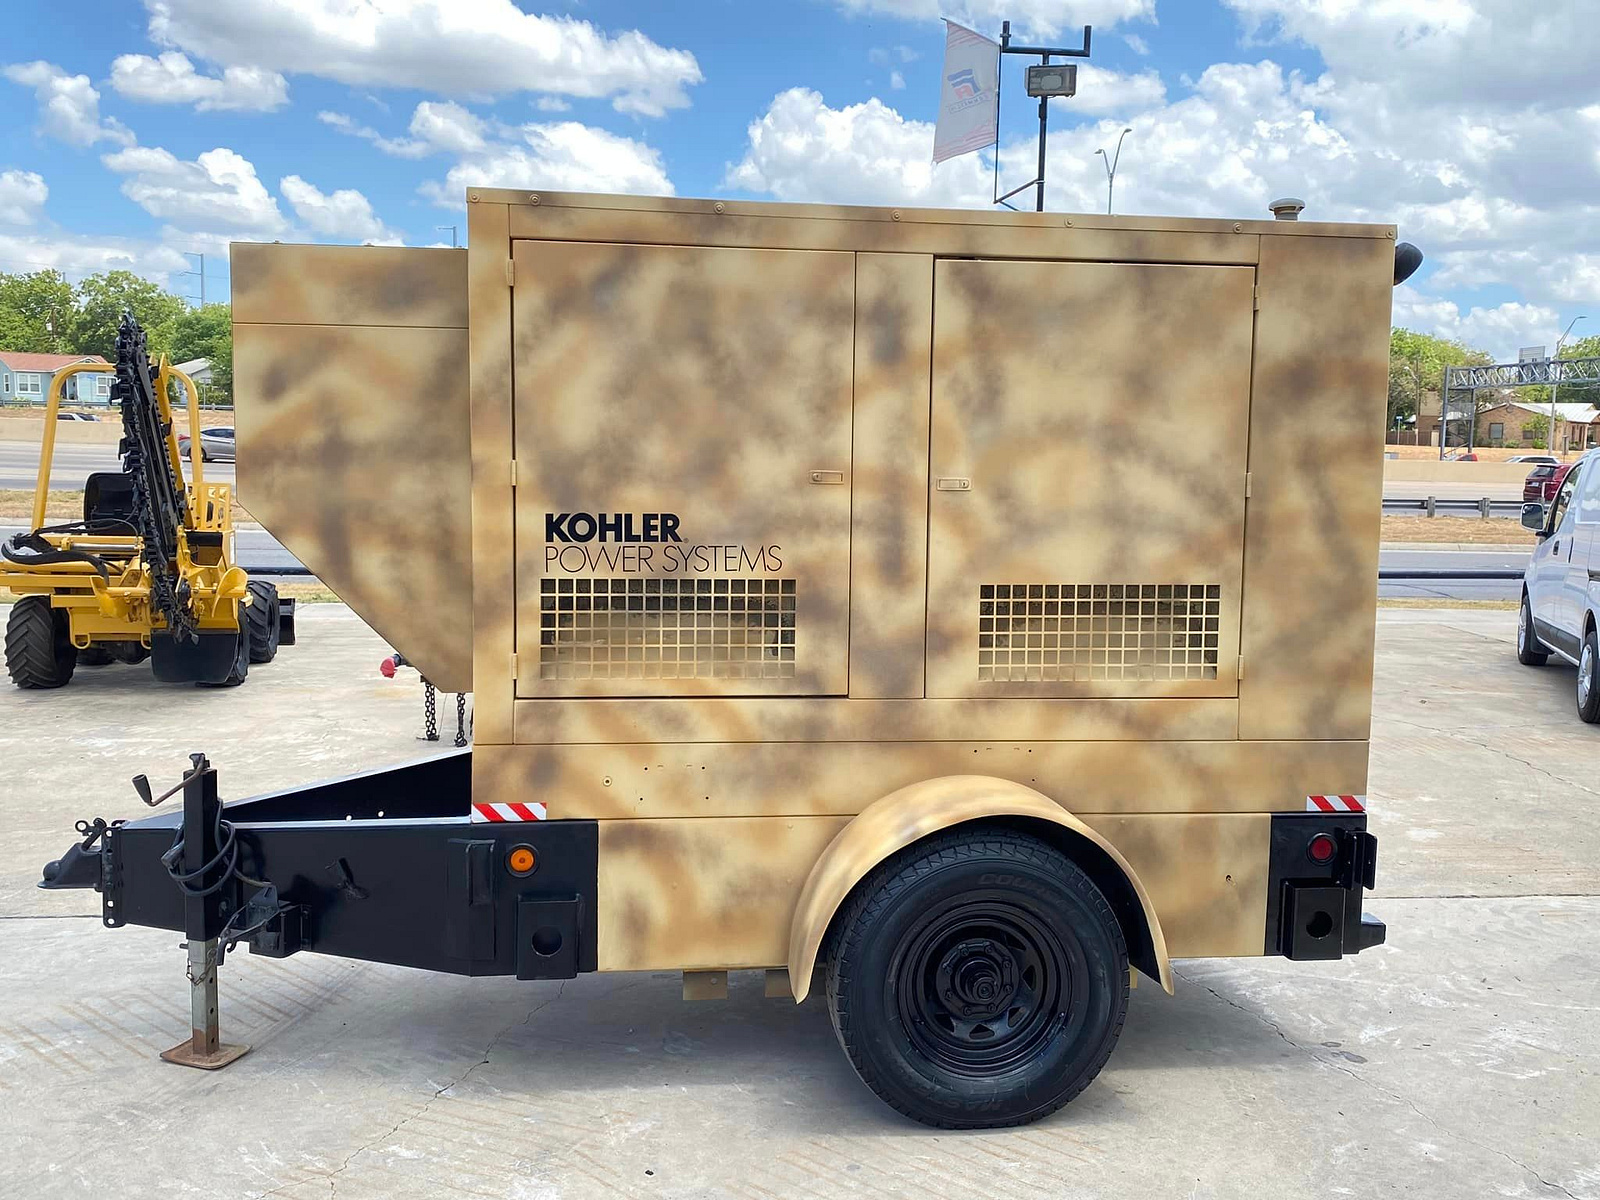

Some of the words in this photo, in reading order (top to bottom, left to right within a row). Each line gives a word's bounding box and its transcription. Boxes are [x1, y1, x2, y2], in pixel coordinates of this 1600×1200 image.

[545, 512, 682, 543] KOHLER
[545, 545, 654, 573] POWER
[662, 545, 783, 572] SYSTEMS
